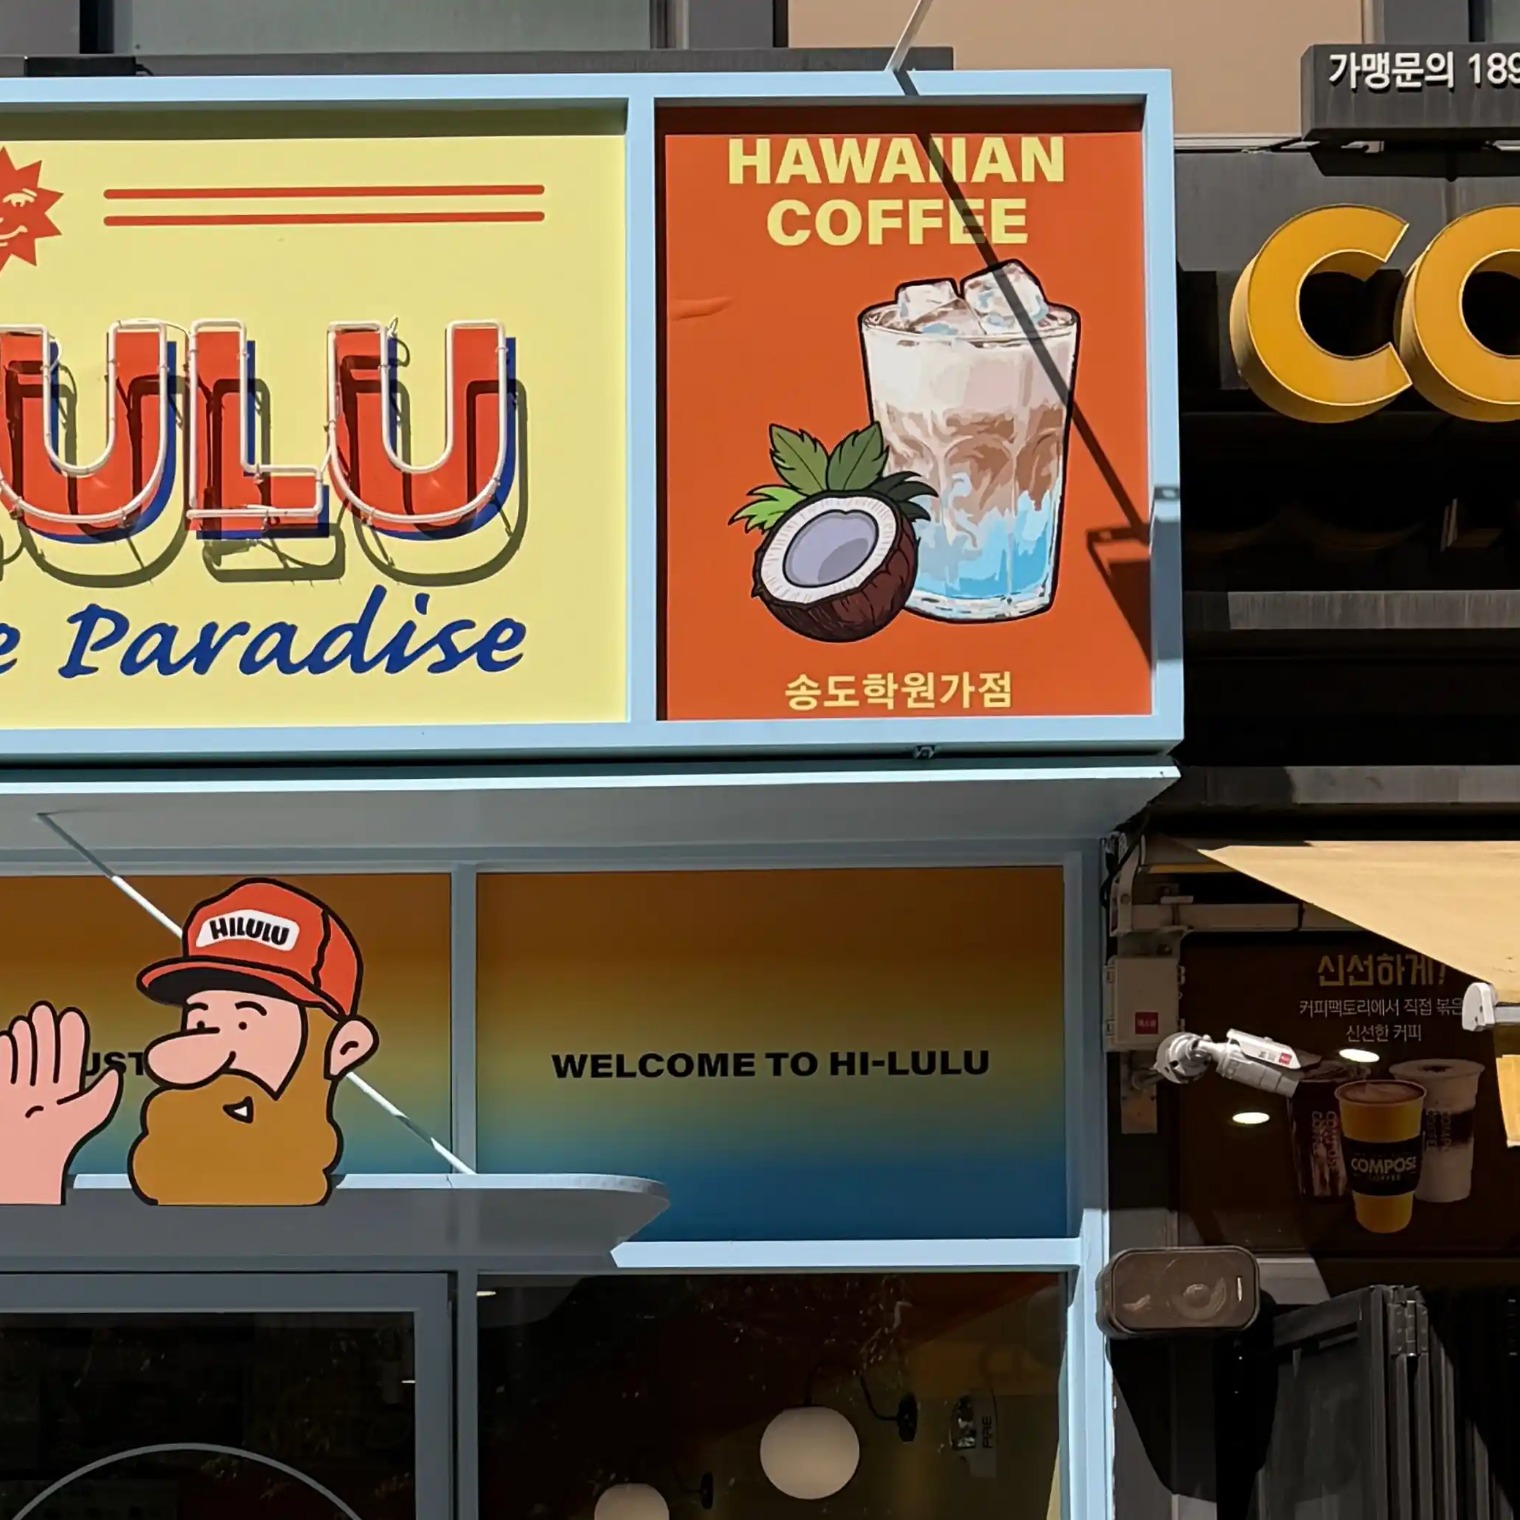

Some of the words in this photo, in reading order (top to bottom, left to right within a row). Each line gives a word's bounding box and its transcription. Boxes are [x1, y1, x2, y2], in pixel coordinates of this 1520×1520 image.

[1329, 51, 1455, 90] 가맹문의
[727, 136, 1066, 185] HAWAIIAN
[766, 197, 1029, 247] COFFEE
[57, 584, 528, 680] Paradise
[784, 671, 1013, 709] 송도학원가점
[208, 916, 291, 947] HILULU
[1346, 1024, 1389, 1043] 신선한
[1393, 1024, 1422, 1042] 커피
[551, 1052, 756, 1079] WELCOME
[764, 1051, 819, 1077] TO
[829, 1050, 990, 1077] HI-LULU
